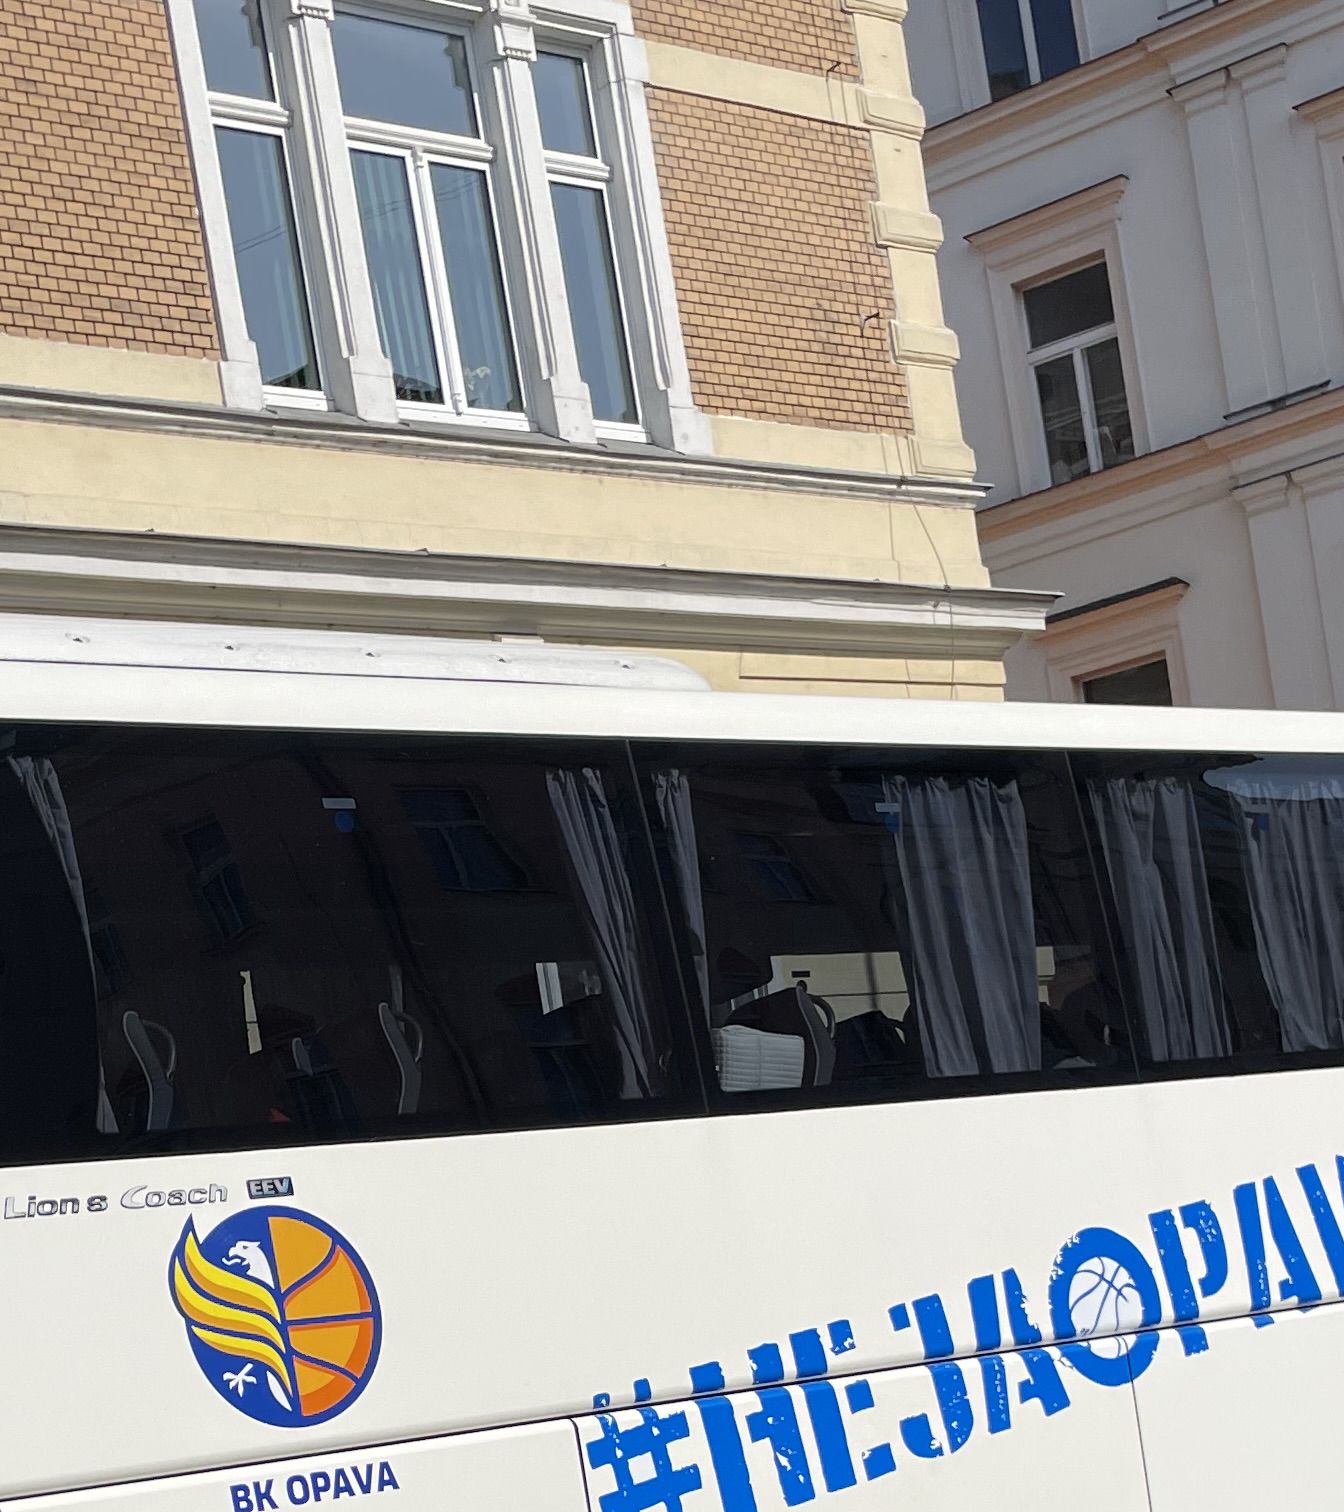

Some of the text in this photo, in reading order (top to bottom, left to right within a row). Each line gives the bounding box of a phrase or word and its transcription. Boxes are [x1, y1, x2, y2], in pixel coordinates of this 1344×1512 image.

[120, 1183, 228, 1209] Coach
[249, 1177, 292, 1197] EEV
[287, 1460, 400, 1506] OPAVA
